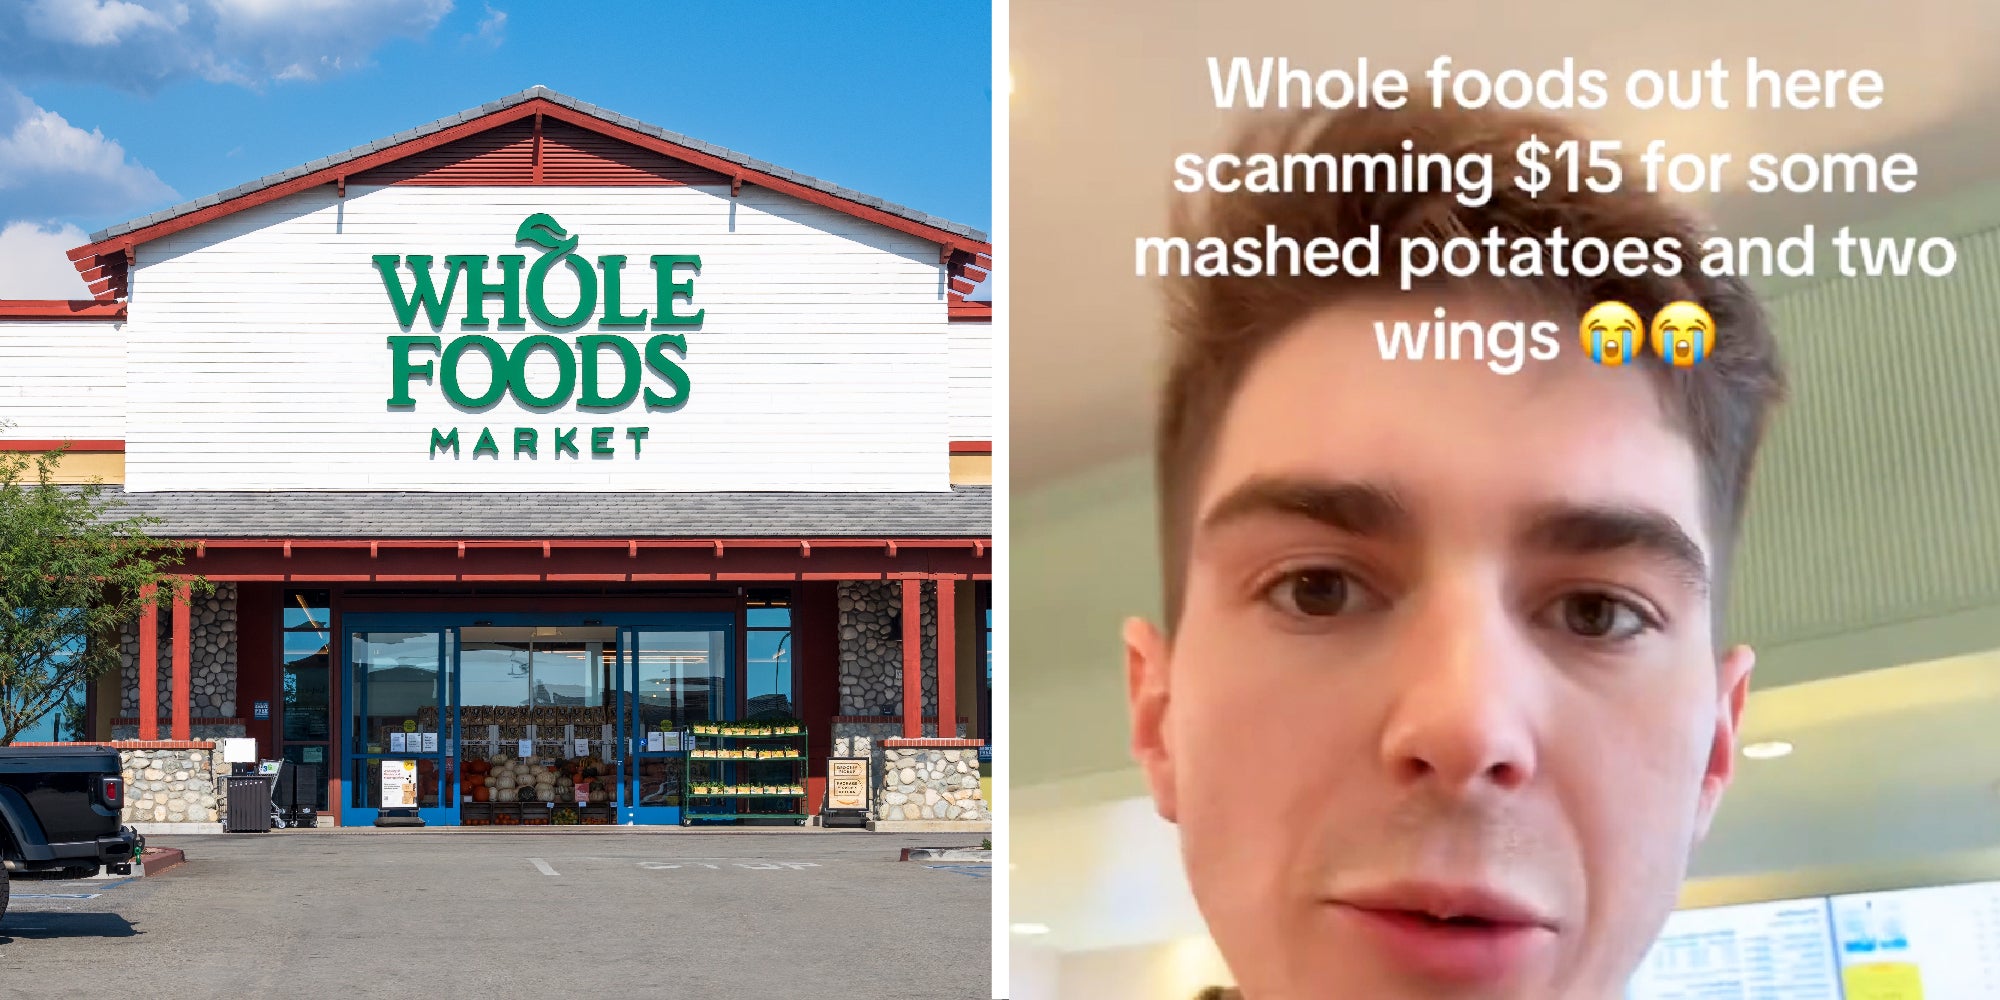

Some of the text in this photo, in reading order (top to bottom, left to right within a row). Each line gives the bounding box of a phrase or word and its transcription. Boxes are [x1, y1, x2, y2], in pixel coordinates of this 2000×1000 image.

[372, 238, 705, 328] WHOLE
[387, 334, 691, 408] FOODS
[429, 427, 649, 456] MARKET
